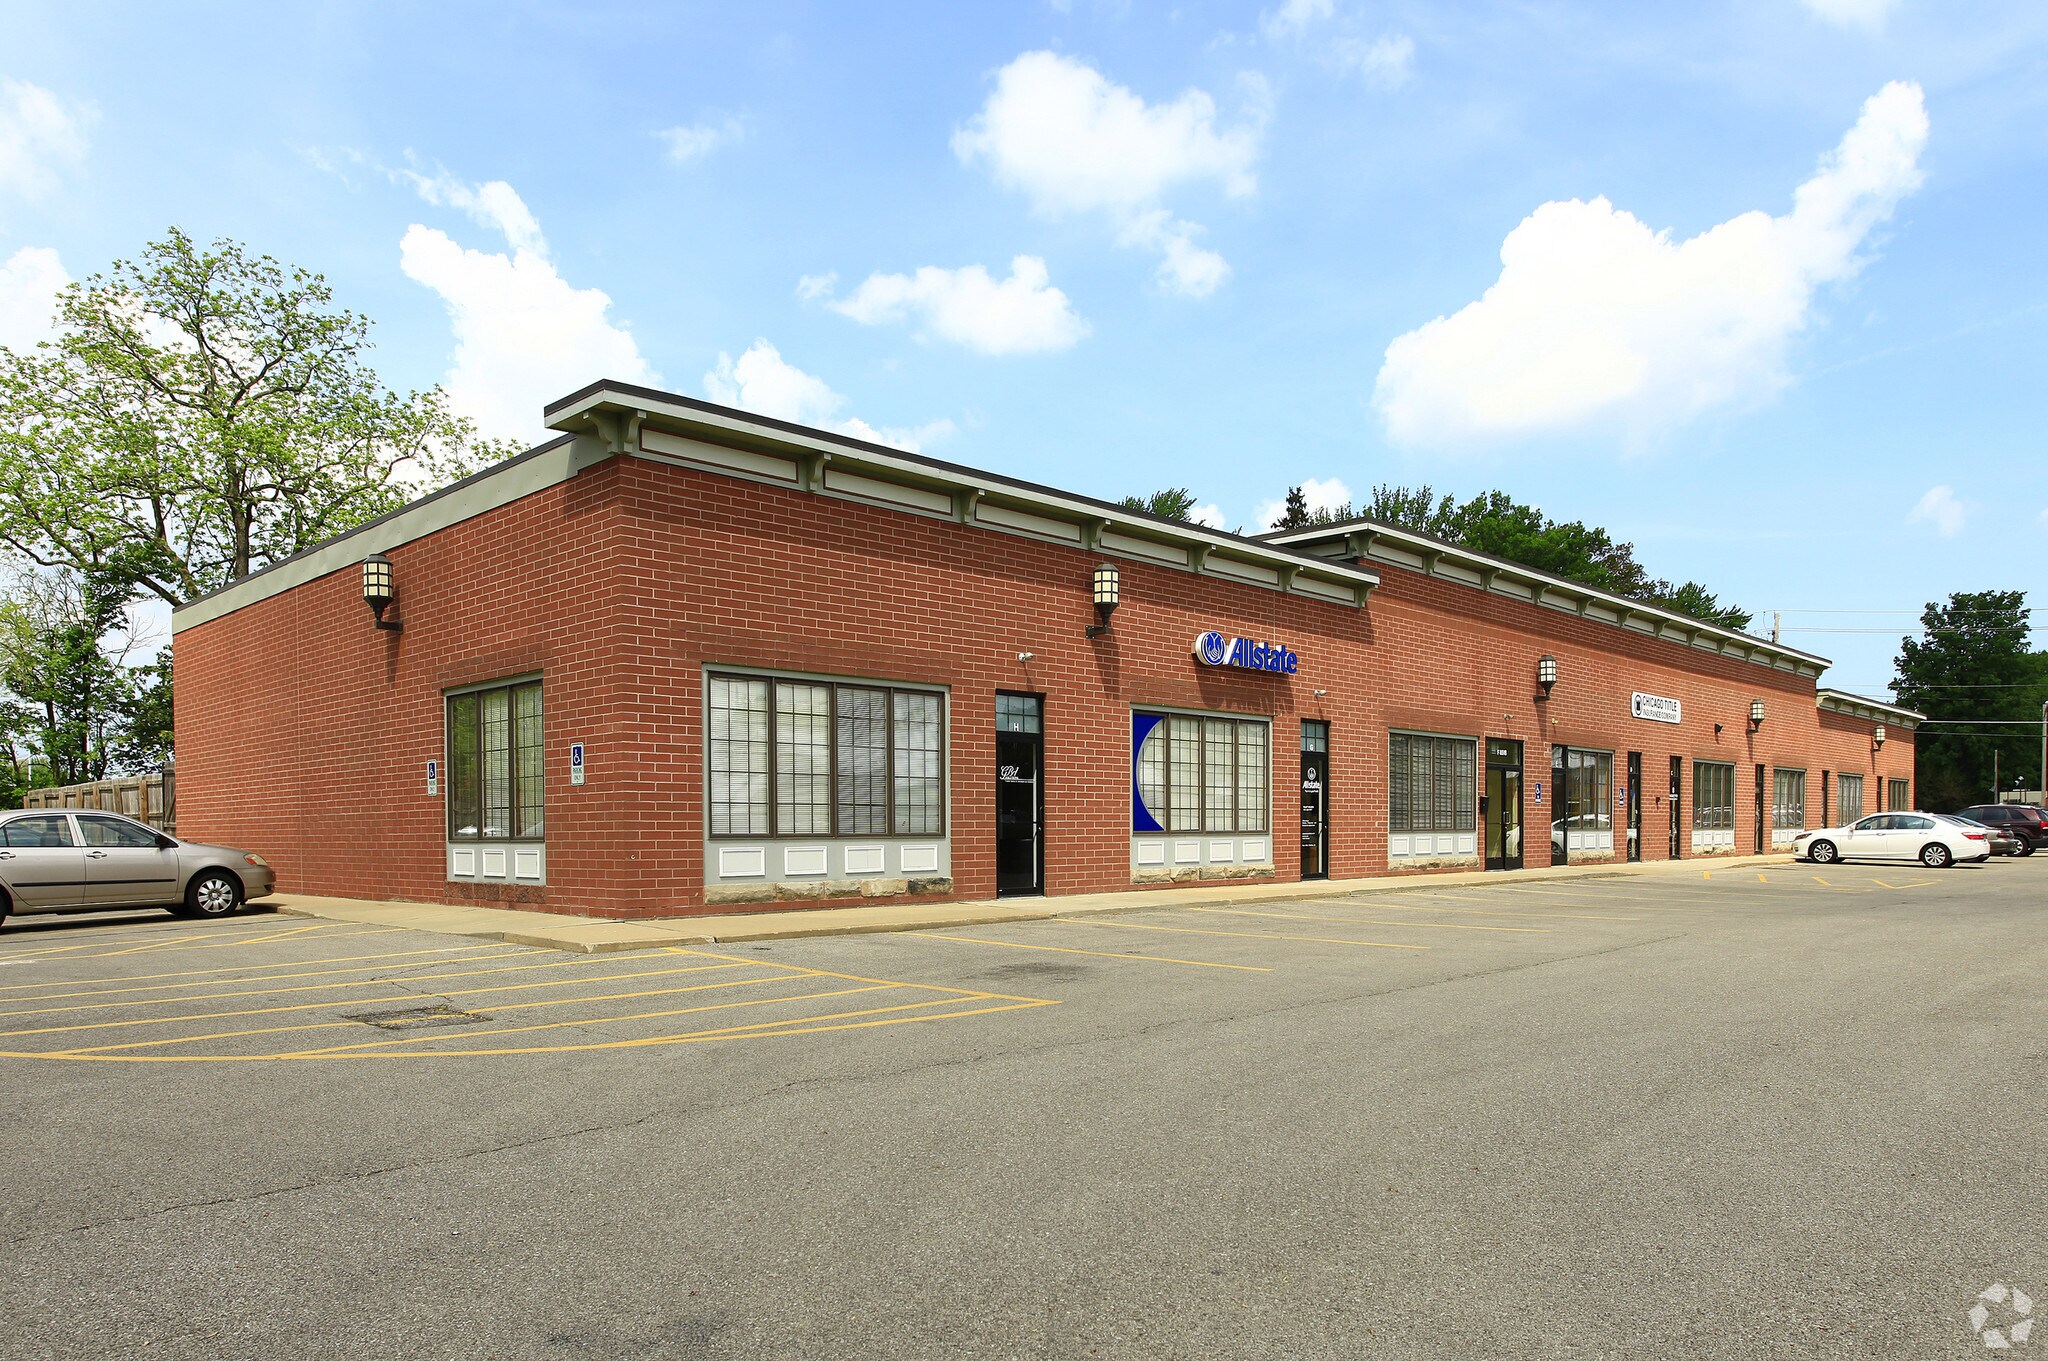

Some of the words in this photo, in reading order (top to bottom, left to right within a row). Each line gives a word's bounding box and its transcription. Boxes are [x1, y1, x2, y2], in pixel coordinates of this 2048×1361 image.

[1227, 637, 1298, 674] Allstate
[1643, 695, 1663, 710] CHICAGO
[1664, 700, 1677, 712] TITLE
[1643, 708, 1661, 719] INSURANCE
[1661, 711, 1677, 721] COMPANY
[1013, 722, 1020, 732] H
[1309, 743, 1315, 751] G
[1302, 780, 1321, 790] Allstate
